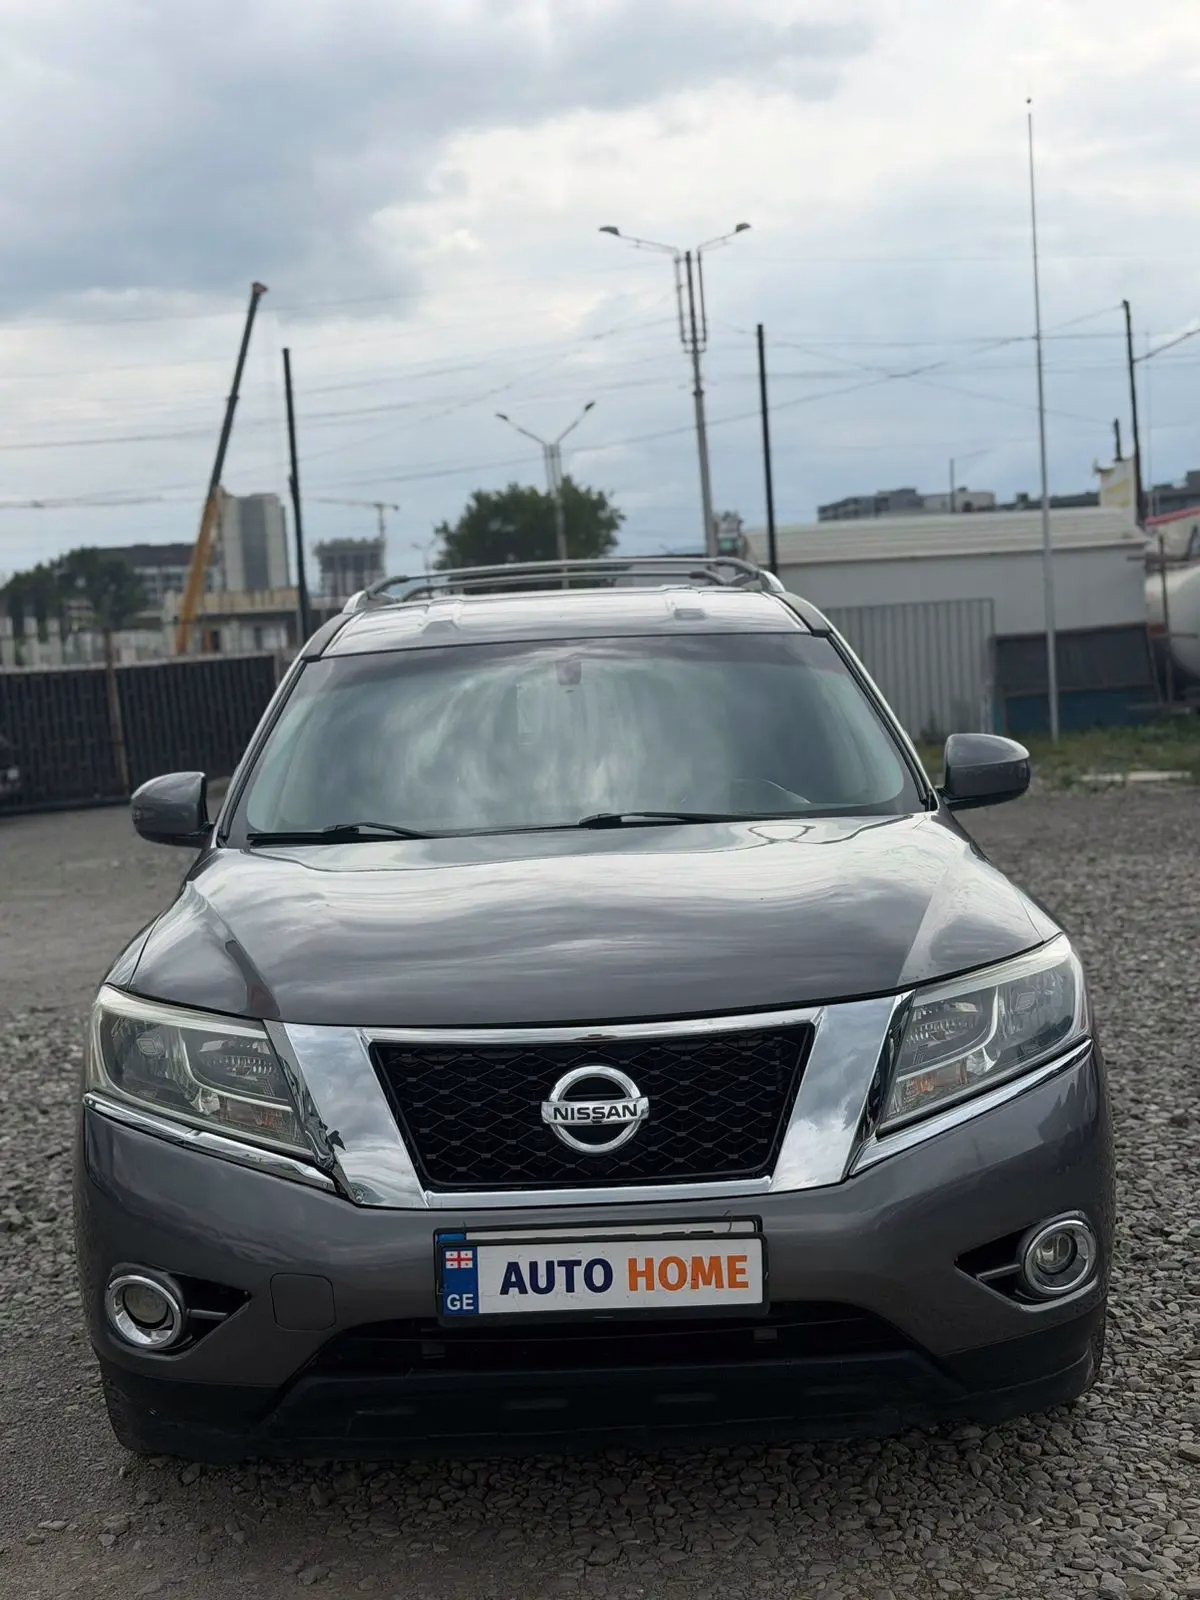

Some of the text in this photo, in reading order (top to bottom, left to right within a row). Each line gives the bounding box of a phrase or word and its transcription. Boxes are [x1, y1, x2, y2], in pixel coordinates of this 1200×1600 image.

[553, 1103, 638, 1121] NISSAN
[499, 1254, 749, 1295] AUTO HOME
[446, 1293, 474, 1310] GE
